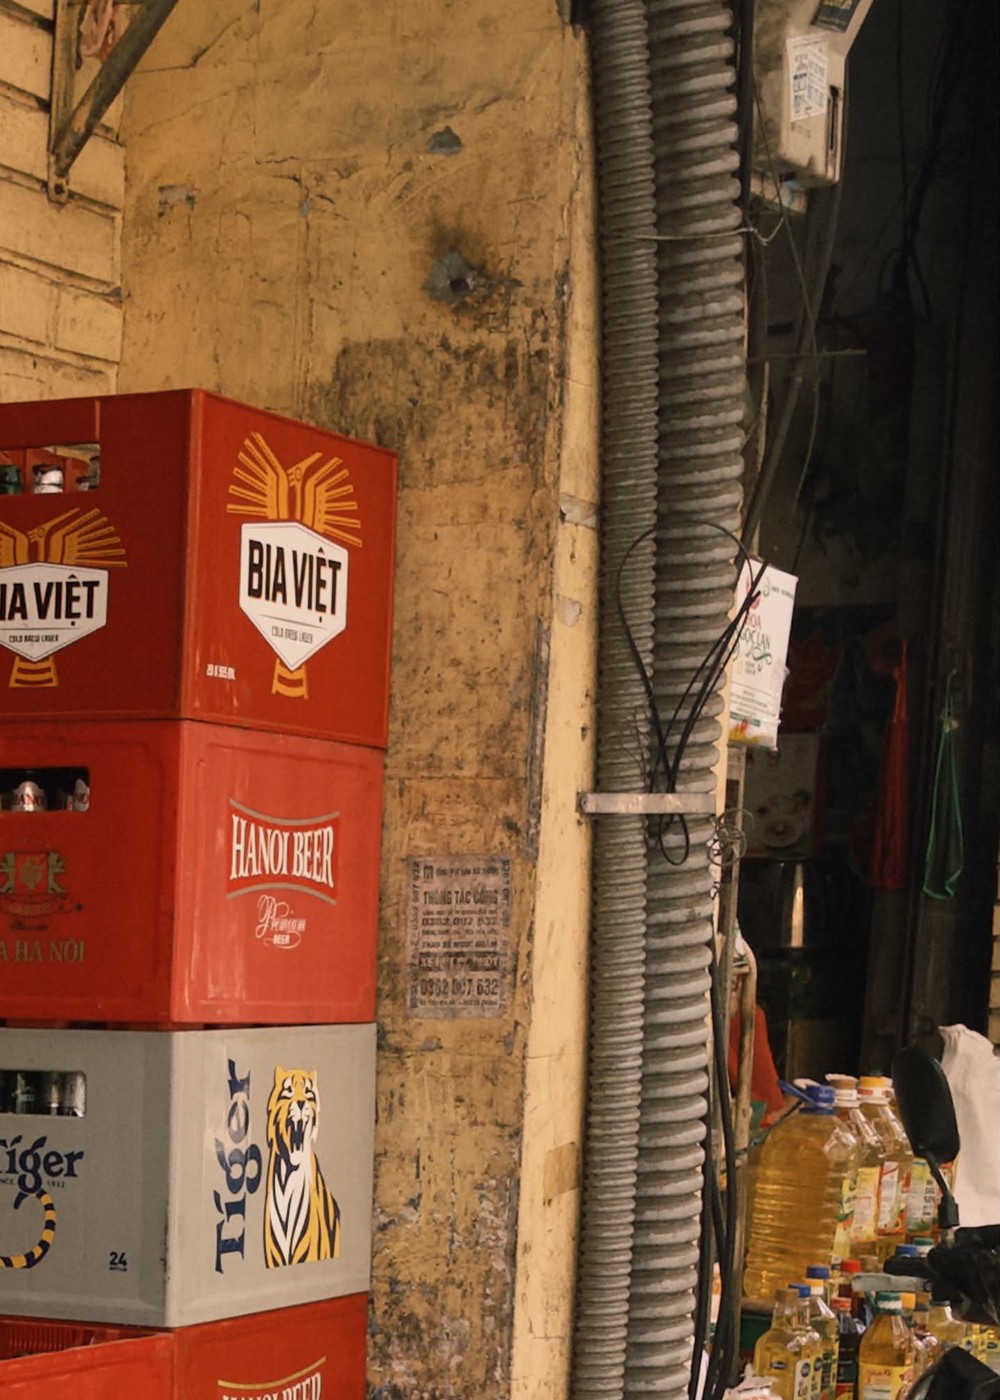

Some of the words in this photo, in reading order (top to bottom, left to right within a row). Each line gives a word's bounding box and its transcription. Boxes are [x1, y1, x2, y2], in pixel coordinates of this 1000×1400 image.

[33, 573, 100, 627] VIỆT
[247, 539, 288, 606] BIA
[292, 546, 342, 624] VIỆT
[229, 813, 290, 881] HANOI
[291, 825, 334, 889] BEER
[213, 1058, 262, 1274] Tiger
[109, 1251, 128, 1266] 24
